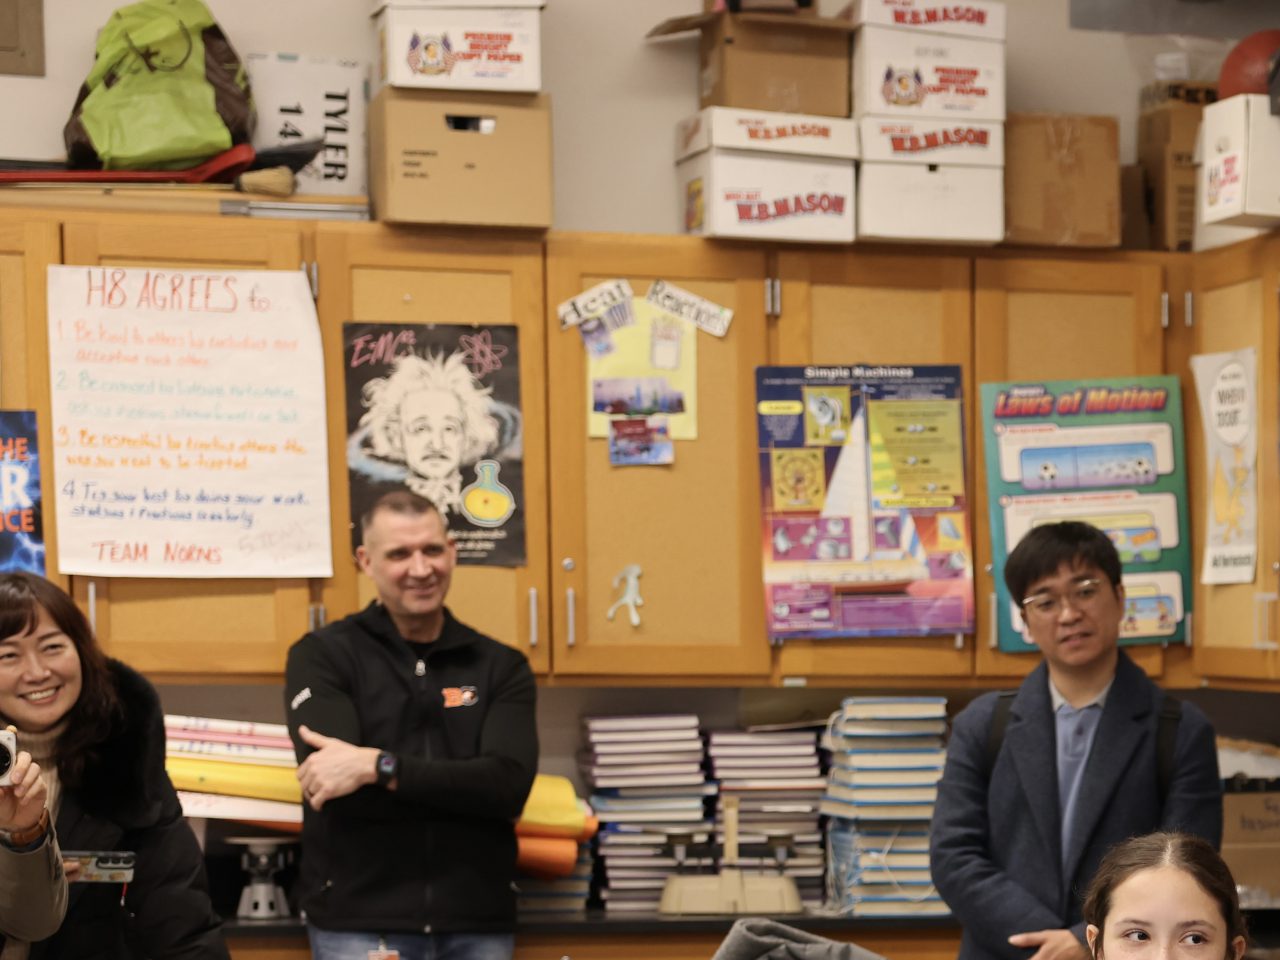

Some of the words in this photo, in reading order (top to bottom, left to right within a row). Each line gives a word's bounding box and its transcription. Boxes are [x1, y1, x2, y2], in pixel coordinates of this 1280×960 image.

[324, 88, 348, 180] TYLER
[87, 266, 127, 309] H8
[136, 270, 238, 313] AGREES
[994, 390, 1053, 418] Laws
[1057, 388, 1083, 415] of
[1085, 384, 1167, 414] Motion
[92, 540, 149, 563] TEAM
[163, 542, 223, 564] NORMS
